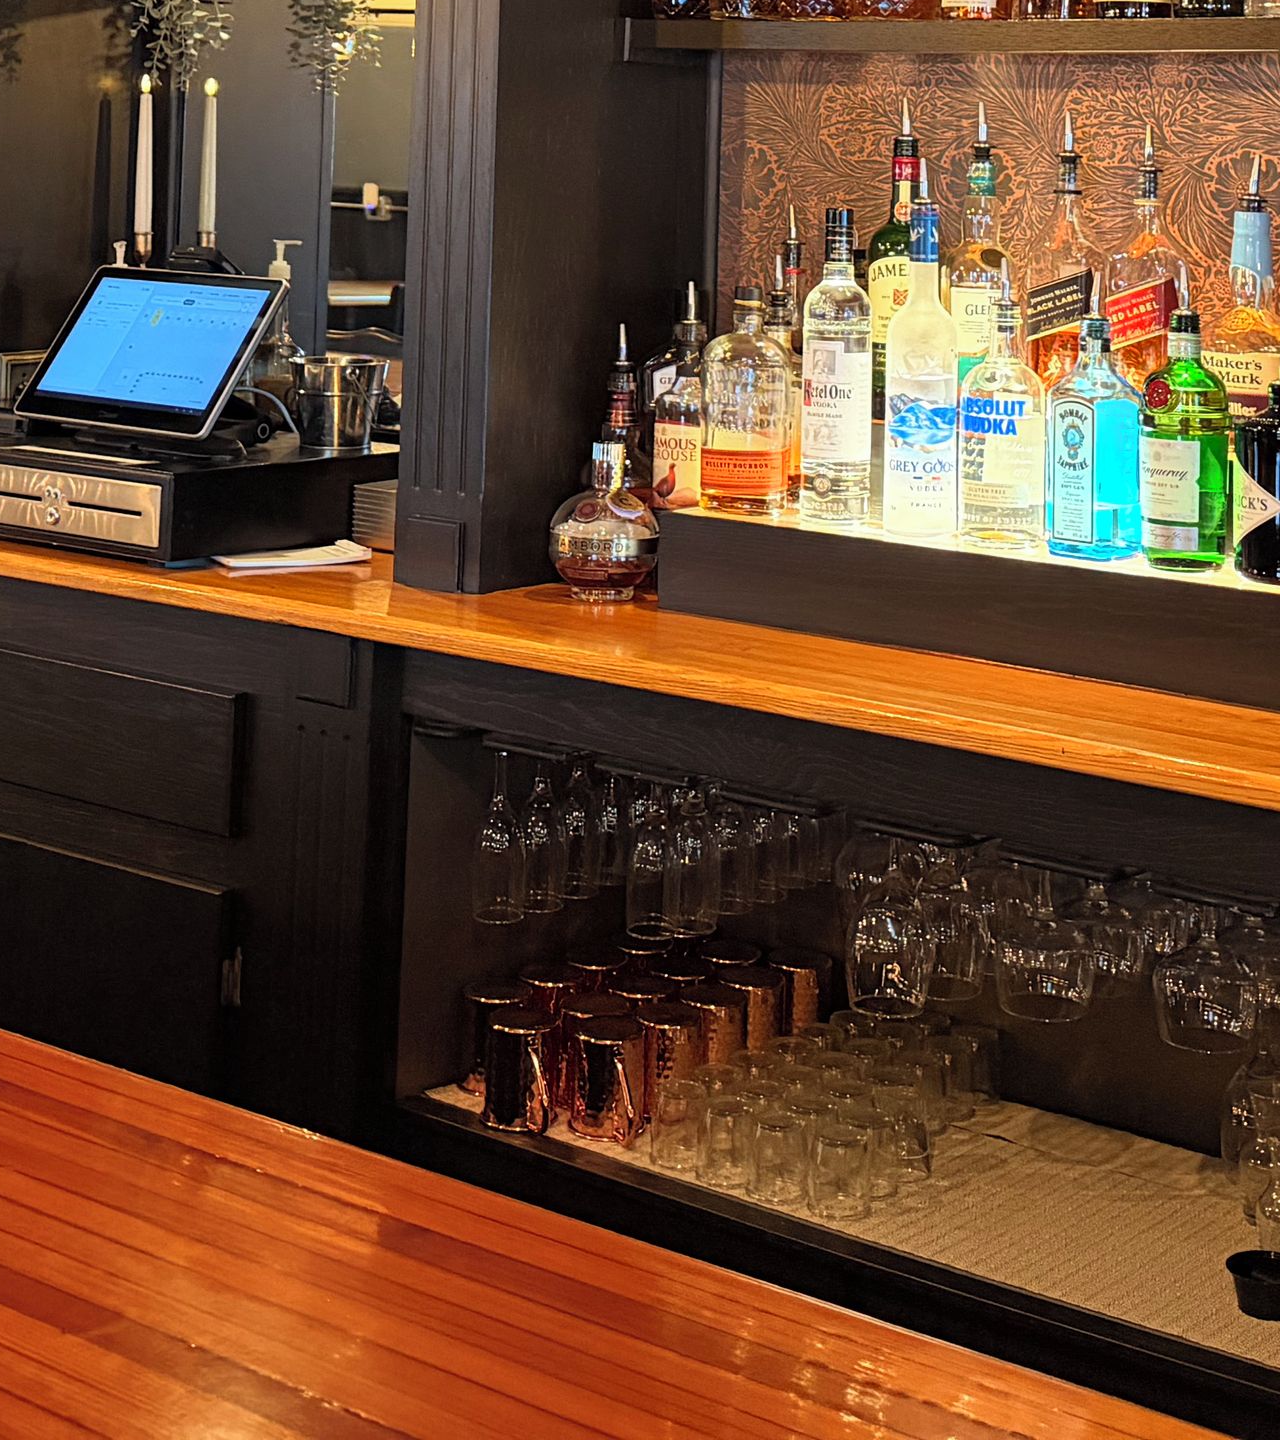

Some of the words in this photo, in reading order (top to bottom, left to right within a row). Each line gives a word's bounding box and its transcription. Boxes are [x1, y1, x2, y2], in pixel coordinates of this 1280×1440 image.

[965, 304, 992, 316] GLE
[1027, 302, 1054, 315] BLACK
[1055, 292, 1084, 306] LABEL
[1107, 312, 1125, 324] RED
[1127, 301, 1160, 318] LABEL
[1203, 355, 1263, 371] Maker's
[1218, 371, 1262, 385] Mark
[804, 382, 827, 400] Ketel
[829, 384, 852, 399] One
[1058, 408, 1089, 424] BOMBAY
[732, 461, 769, 470] BOURBON
[890, 459, 919, 473] GREY
[1057, 455, 1090, 472] SAPPHIRE
